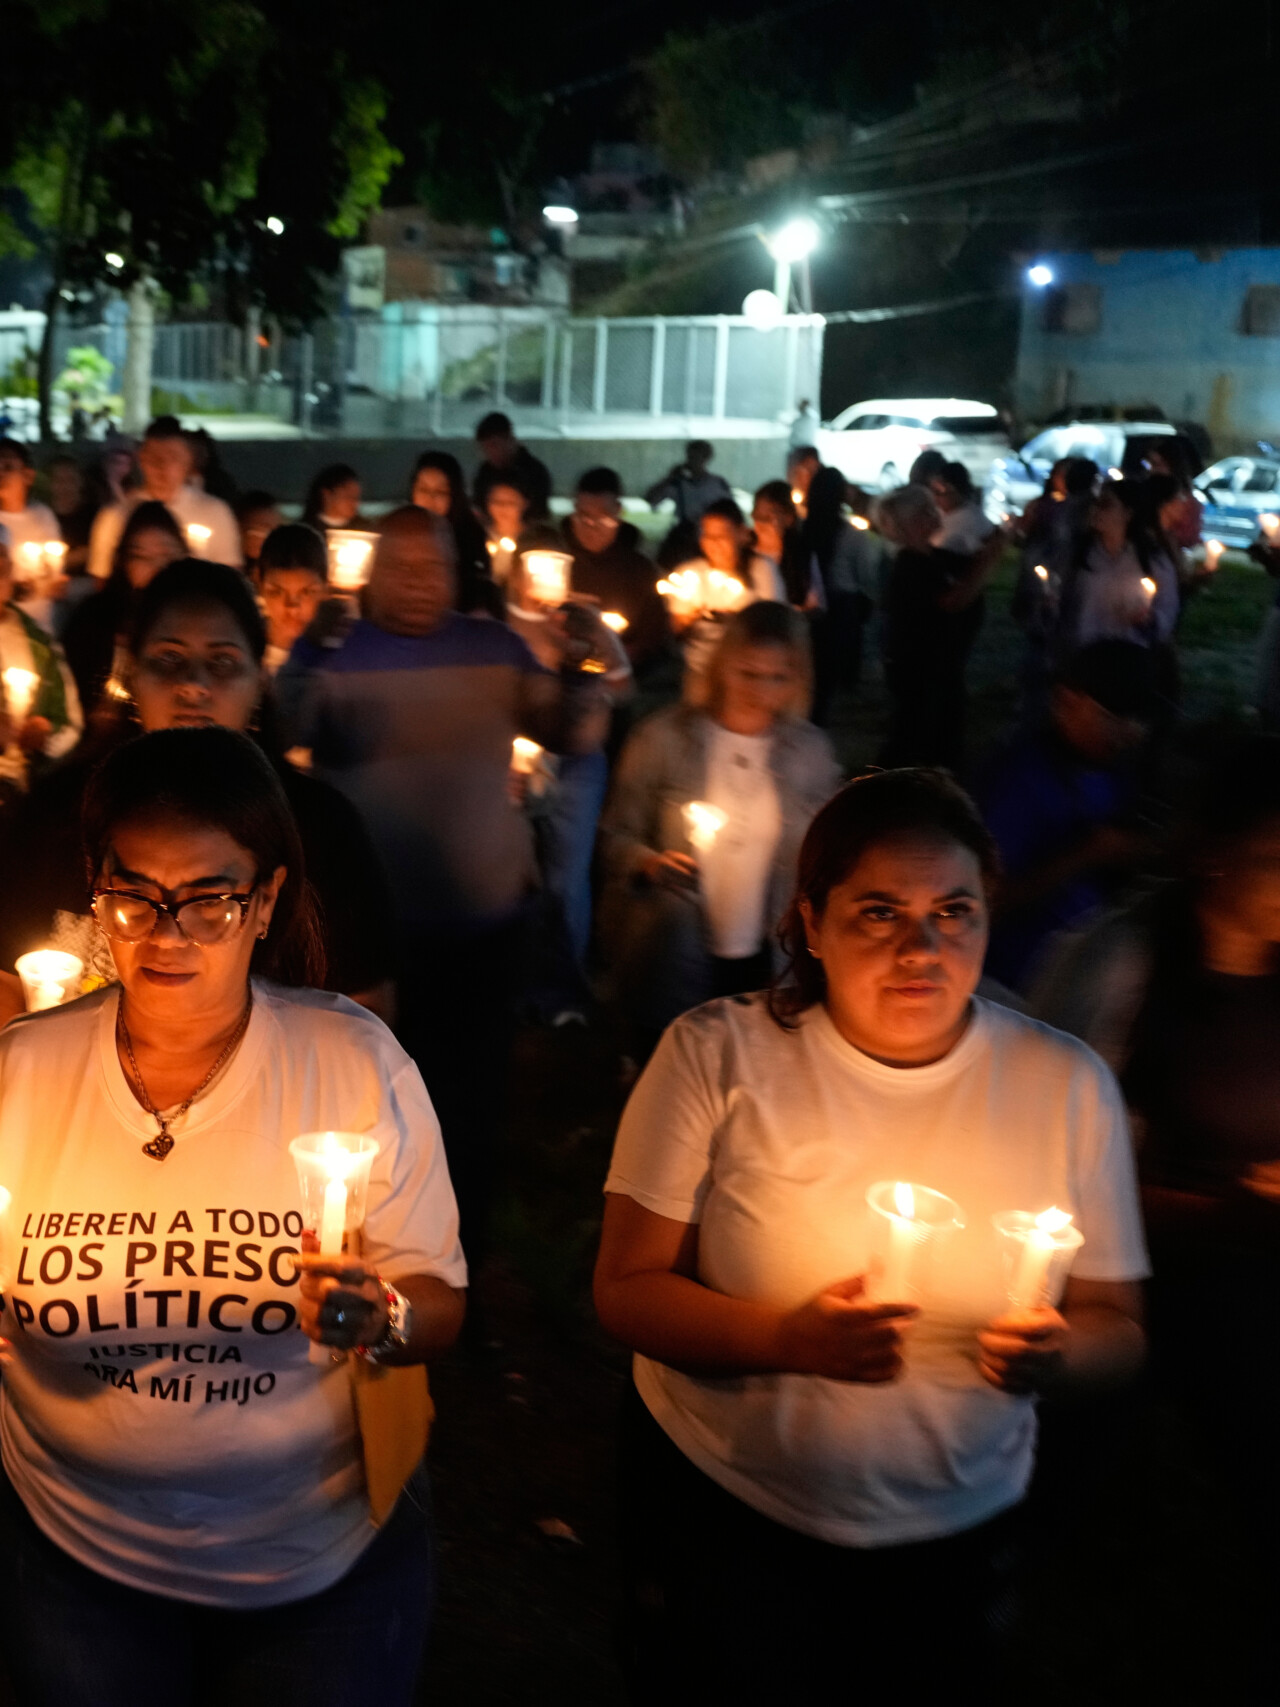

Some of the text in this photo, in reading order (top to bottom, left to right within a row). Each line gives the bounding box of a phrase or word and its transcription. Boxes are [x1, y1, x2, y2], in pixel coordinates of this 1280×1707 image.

[21, 1208, 304, 1239] LIBEREN A TODO
[16, 1240, 302, 1287] LOS PRESO
[12, 1279, 301, 1338] POLÍTICO
[83, 1362, 276, 1405] ARA MÍ HIJO
